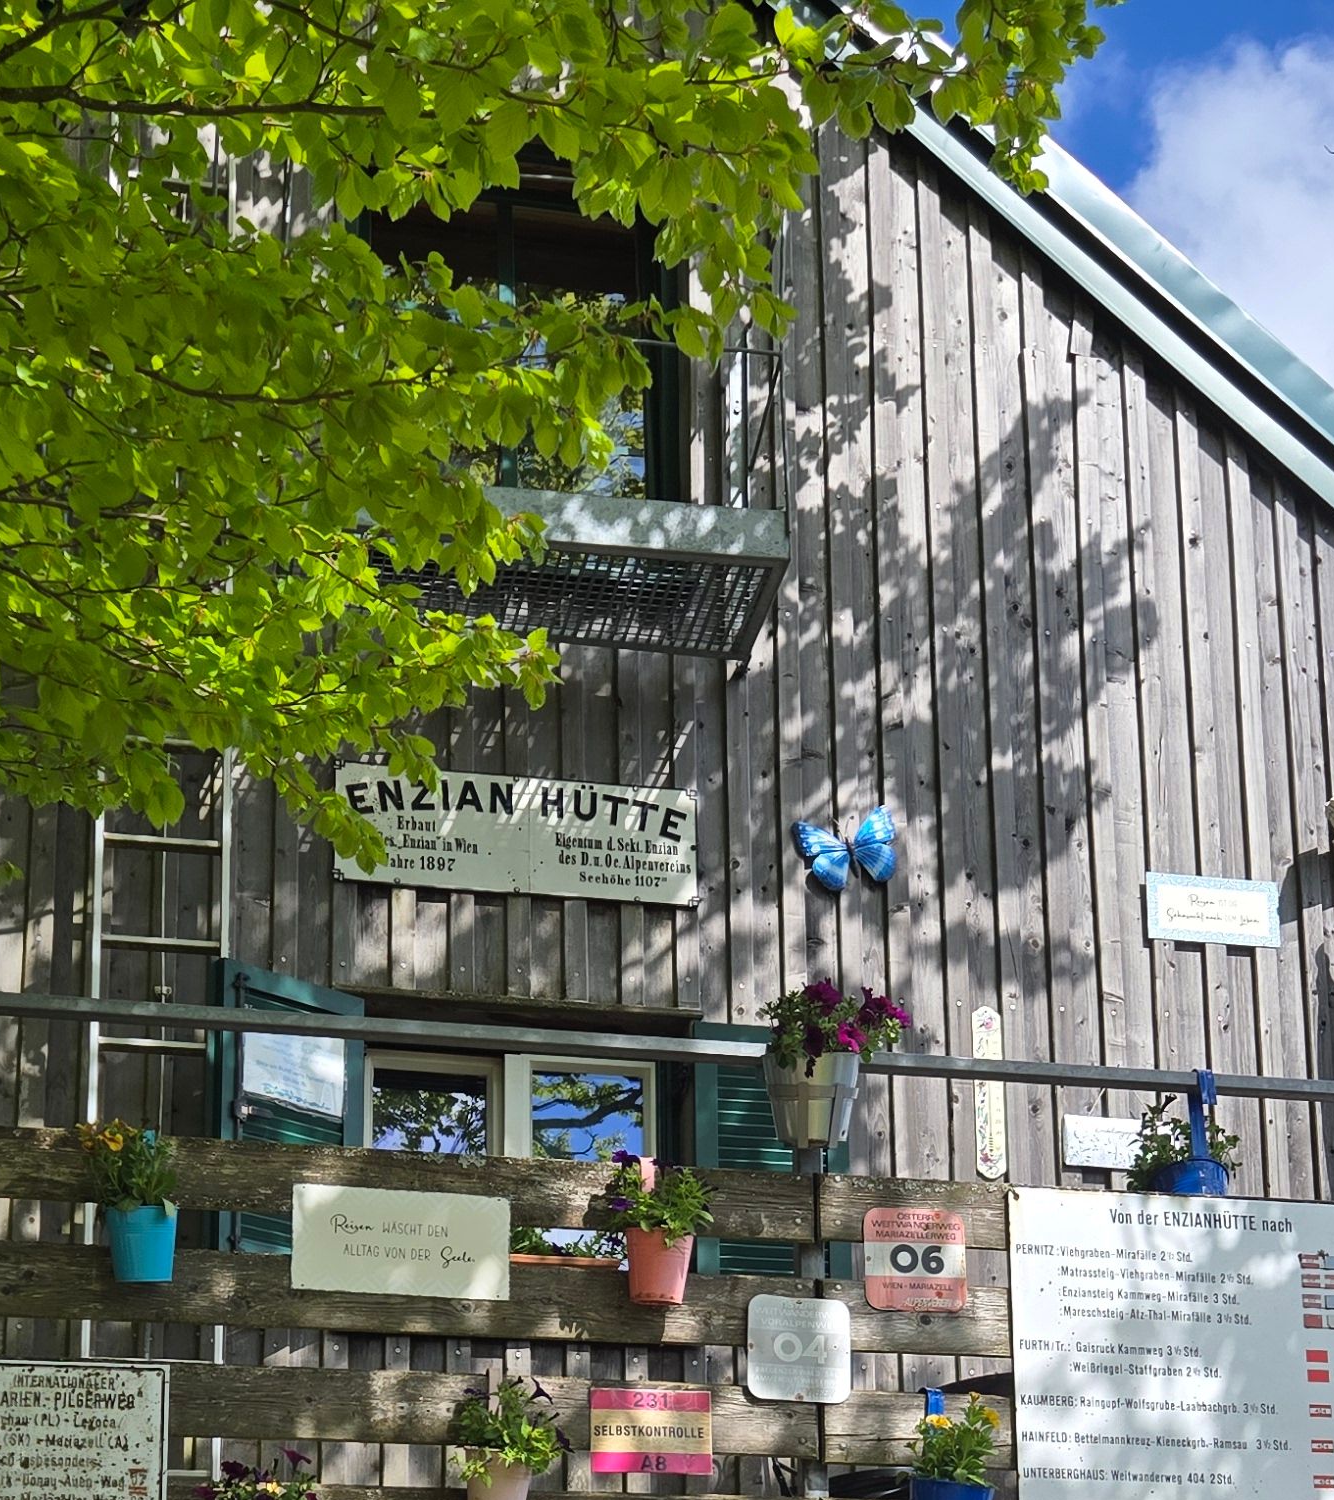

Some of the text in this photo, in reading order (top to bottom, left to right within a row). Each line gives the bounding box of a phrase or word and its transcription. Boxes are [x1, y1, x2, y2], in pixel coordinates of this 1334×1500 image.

[345, 779, 687, 843] ENZIAN HÜTTE
[397, 815, 436, 832] Erbaut
[442, 838, 479, 855] in Wien
[555, 832, 603, 851] Eigentum
[617, 837, 643, 853] Sekt.
[645, 840, 679, 856] Enzian
[419, 856, 456, 872] 1897
[558, 850, 577, 866] des
[579, 871, 631, 887] Seehöhe
[330, 1213, 449, 1238] Reisen WÄSCHT DEN
[1110, 1208, 1293, 1234] Von der ENZIANHÜTTE nach
[875, 1230, 956, 1241] MARIAZELLERWEG
[343, 1243, 380, 1258] ALLTAG
[384, 1246, 406, 1260] VON
[410, 1248, 431, 1261] DER
[889, 1244, 945, 1275] 06
[1176, 1251, 1193, 1263] Std.
[882, 1282, 954, 1292] WIEN MARIAZELL
[1236, 1273, 1254, 1286] Std.
[1117, 1288, 1209, 1304] Kammweg-Mirafälle
[1213, 1293, 1219, 1304] 3
[1222, 1293, 1241, 1306] Std.
[1234, 1313, 1252, 1326] Std.
[773, 1331, 828, 1365] 04
[1075, 1341, 1115, 1355] Gaisruck
[1117, 1343, 1164, 1358] Kammweg
[1183, 1346, 1203, 1358] Std.
[1203, 1366, 1223, 1379] Std.
[633, 1392, 668, 1408] 231
[1020, 1394, 1078, 1408] KAUMBERG:
[1260, 1403, 1279, 1416] Std.
[593, 1424, 705, 1439] SELBSTKONTROLLE
[1021, 1431, 1072, 1444] HAINFELD:
[1272, 1440, 1293, 1452] Std.
[640, 1454, 668, 1471] A8
[1022, 1467, 1108, 1482] UNTERBERGHAUS:
[1110, 1469, 1183, 1486] Weitwanderweg
[1186, 1473, 1205, 1484] 404
